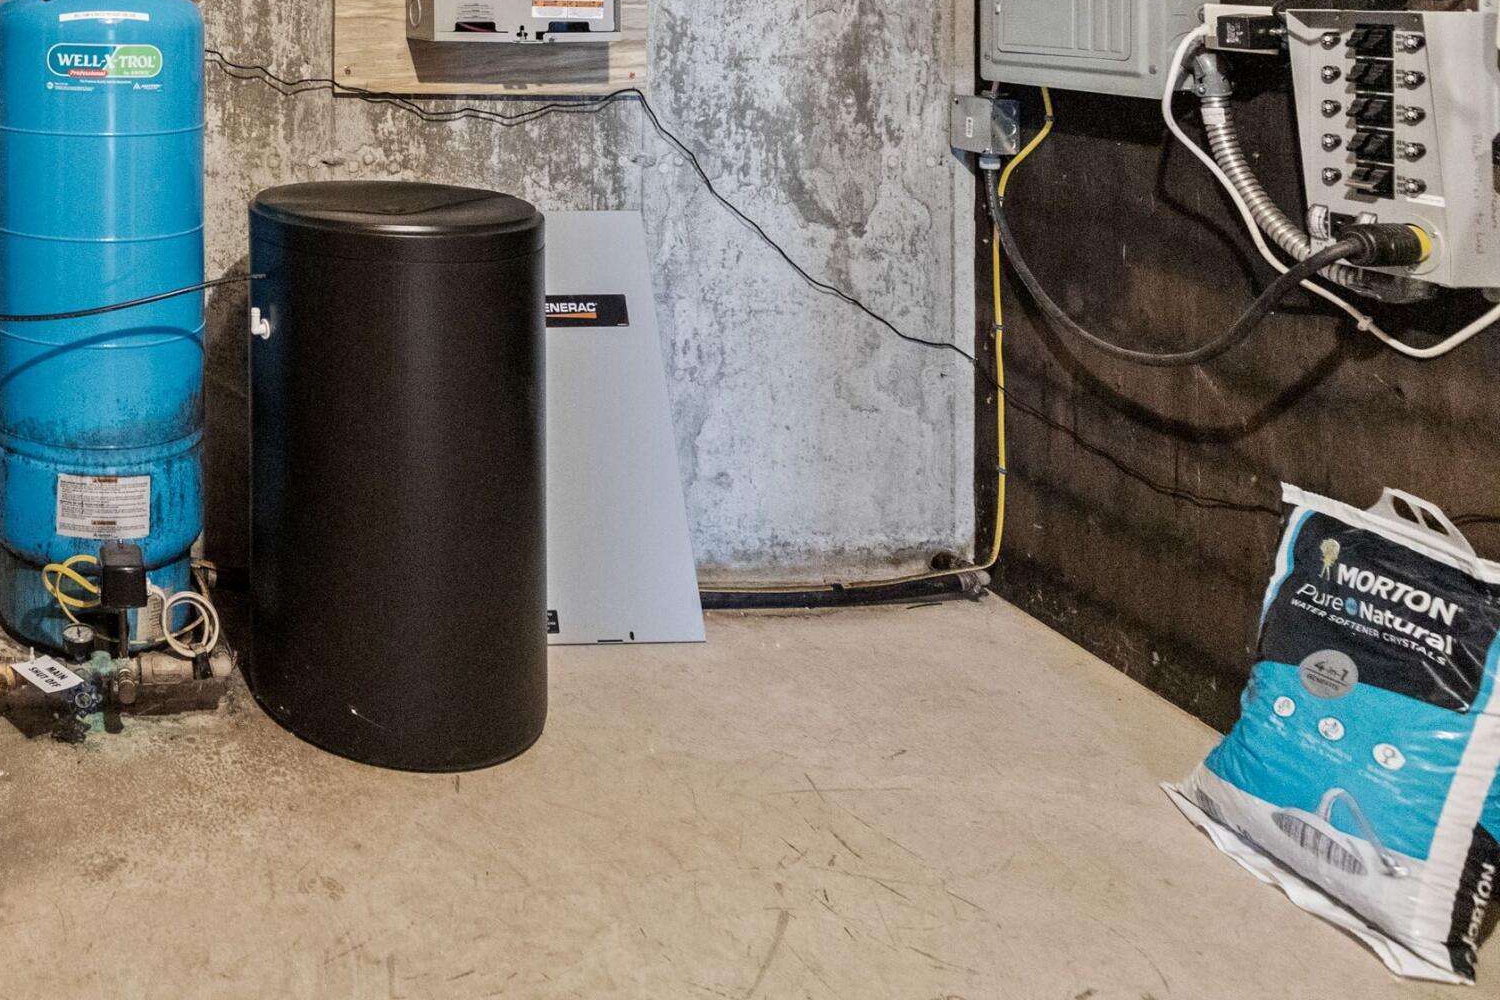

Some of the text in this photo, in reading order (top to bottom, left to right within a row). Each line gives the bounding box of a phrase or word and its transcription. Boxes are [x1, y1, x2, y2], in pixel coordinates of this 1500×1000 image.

[69, 69, 106, 77] Professional
[545, 302, 596, 313] ENERAC
[1337, 562, 1457, 627] MORTON
[1295, 583, 1453, 656] Pure Natural
[1290, 598, 1447, 666] WATER SOFTENER CRYSTALS
[28, 666, 61, 688] SHUT OFF
[46, 666, 69, 681] MAIN
